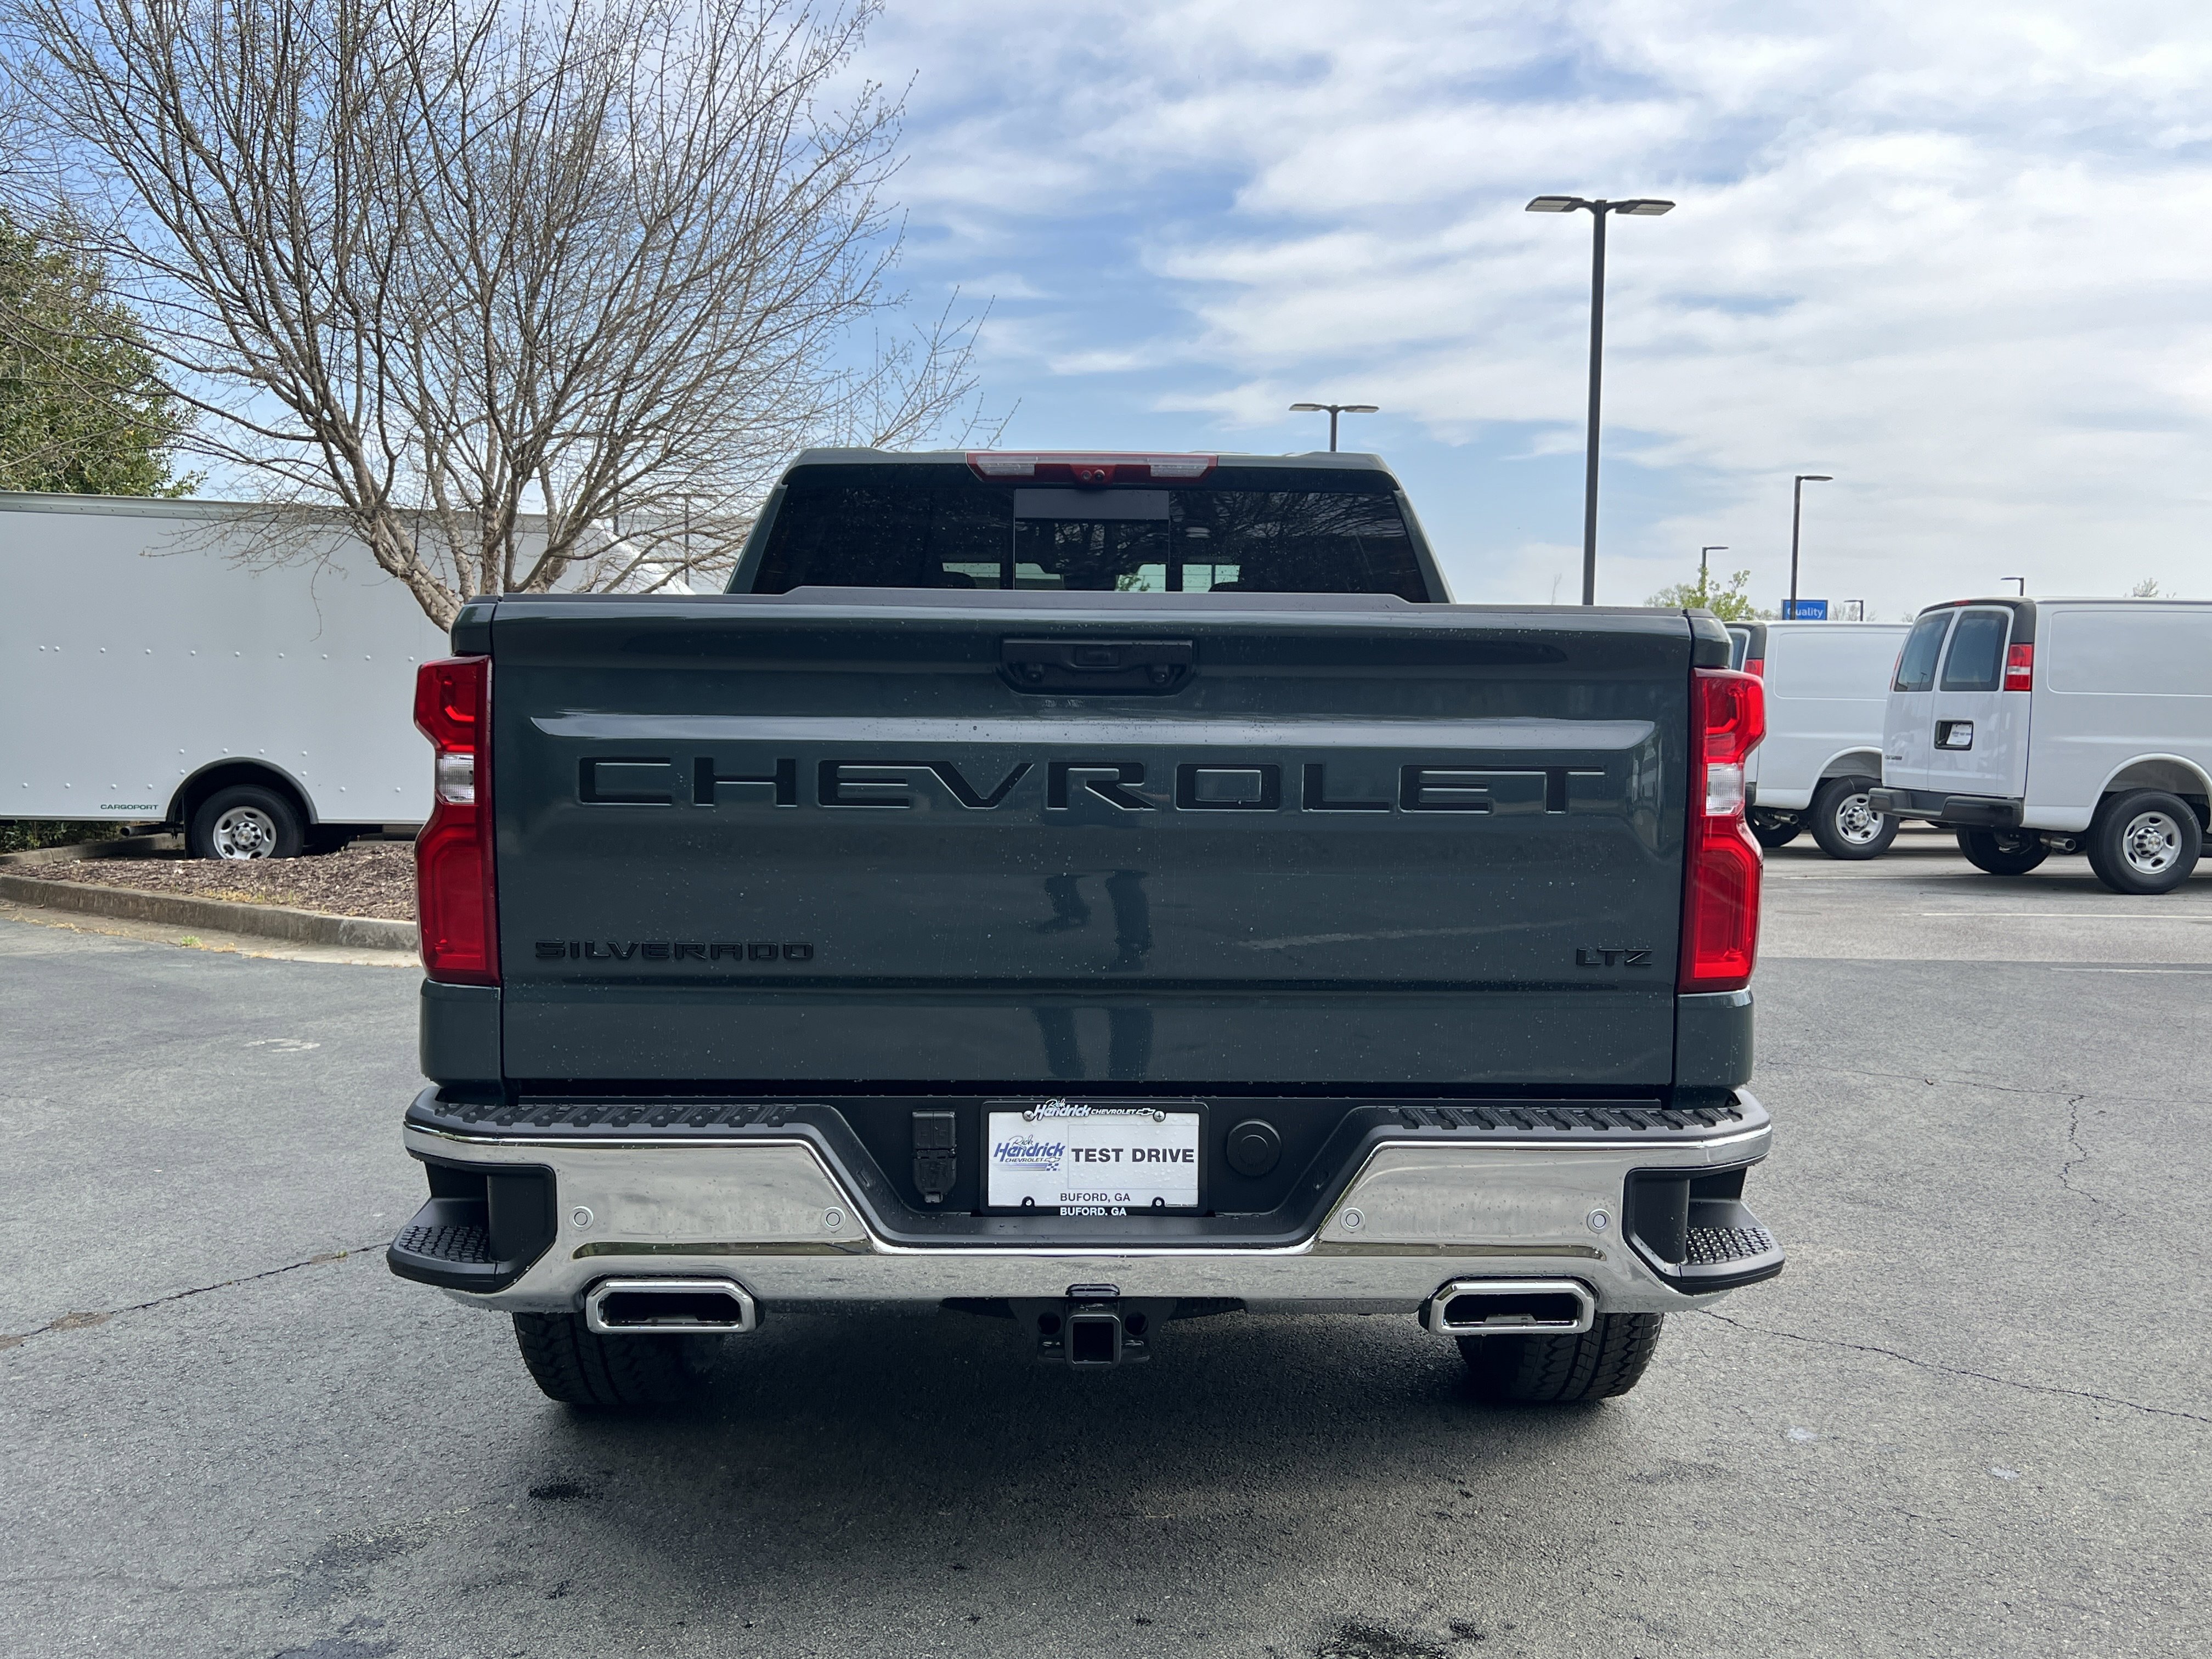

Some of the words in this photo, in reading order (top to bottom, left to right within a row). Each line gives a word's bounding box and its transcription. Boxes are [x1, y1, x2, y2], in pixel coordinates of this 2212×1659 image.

[579, 757, 1605, 814] CHEVROLET
[535, 941, 814, 961] SILVERADO
[1576, 948, 1652, 966] LTZ
[1032, 1104, 1091, 1120] Hendrick
[1008, 1134, 1034, 1149] Rick
[994, 1142, 1065, 1162] Hendrick
[1071, 1148, 1124, 1163] TEST
[1132, 1148, 1194, 1163] DRIVE
[1060, 1193, 1110, 1203] BUFORD,
[1114, 1193, 1131, 1201] GA
[1111, 1207, 1127, 1216] GA
